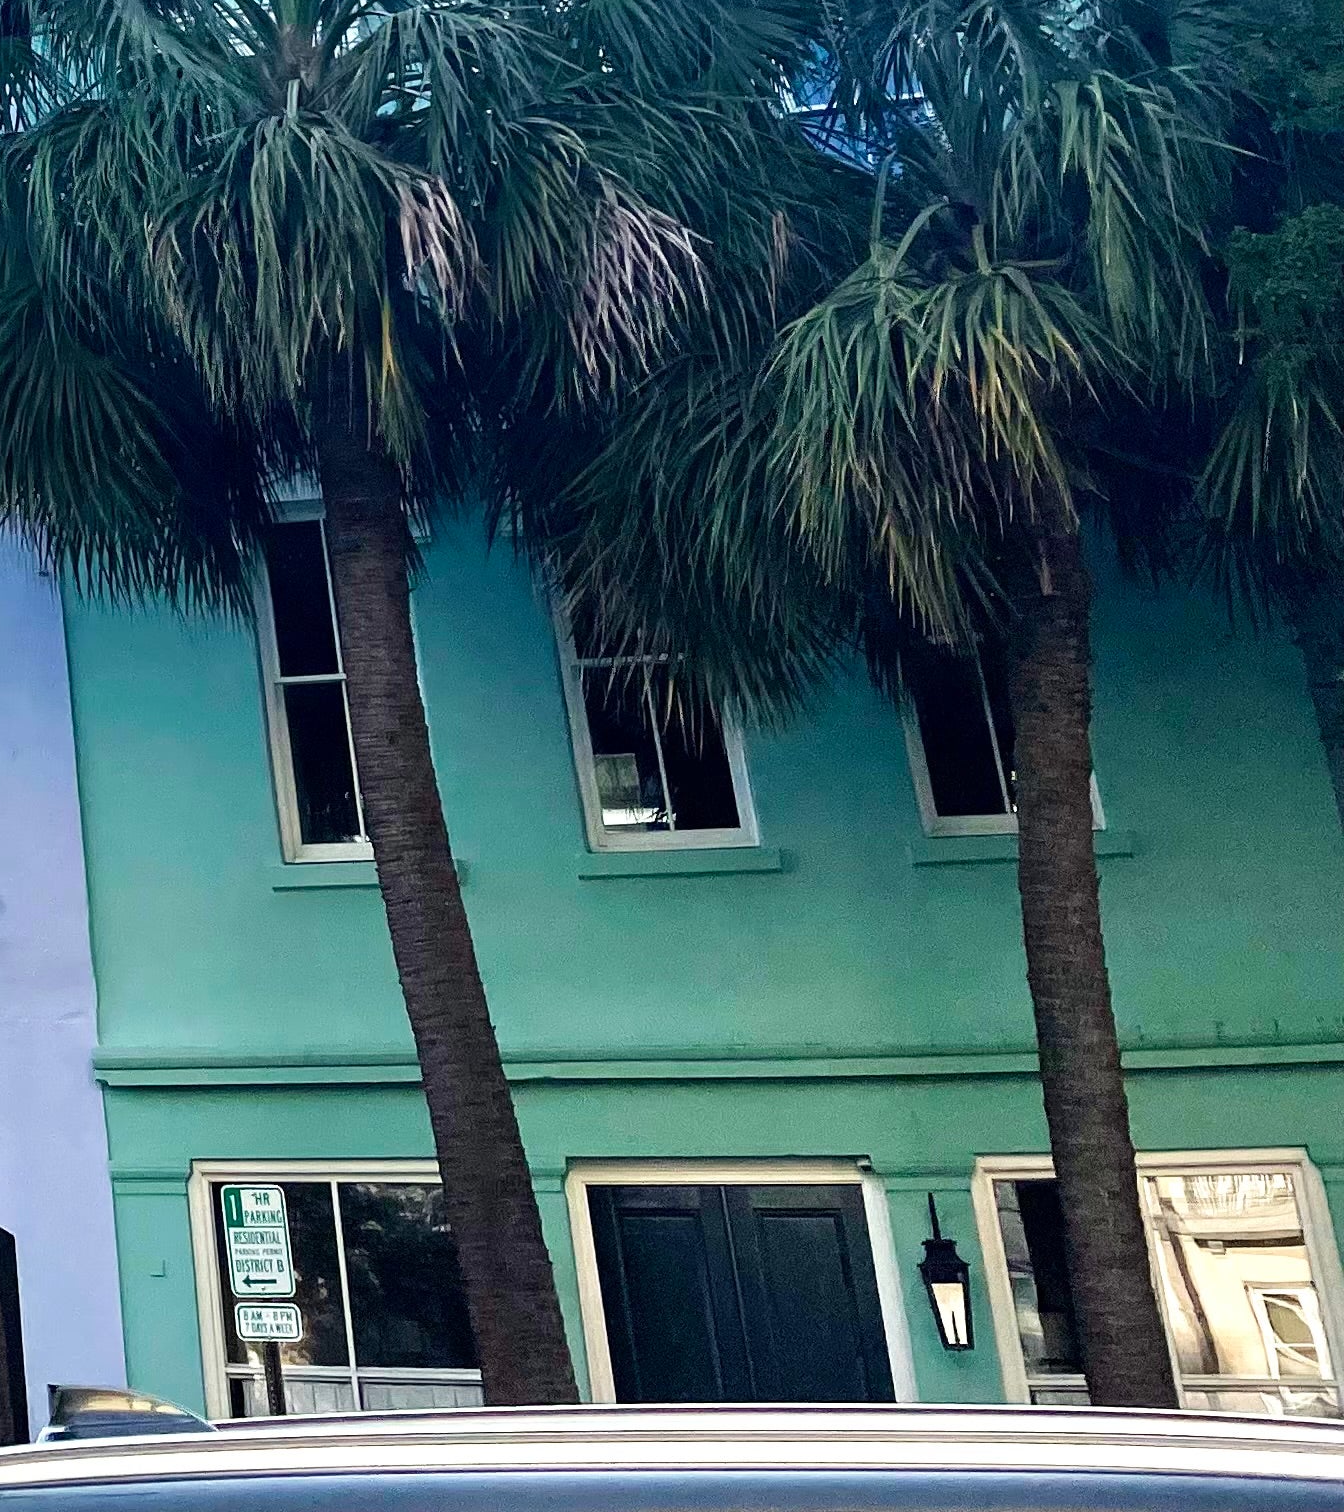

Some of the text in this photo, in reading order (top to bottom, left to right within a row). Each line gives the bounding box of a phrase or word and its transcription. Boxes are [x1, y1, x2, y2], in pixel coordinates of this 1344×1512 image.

[228, 1192, 271, 1221] 1 HR
[244, 1210, 282, 1223] PARKING
[233, 1231, 282, 1245] RESIDENTIAL
[235, 1259, 285, 1273] DISTRICT B
[250, 1310, 263, 1321] AM
[280, 1311, 293, 1321] PM
[251, 1322, 268, 1334] DAYS
[269, 1323, 275, 1334] A
[275, 1323, 294, 1335] WEEK
